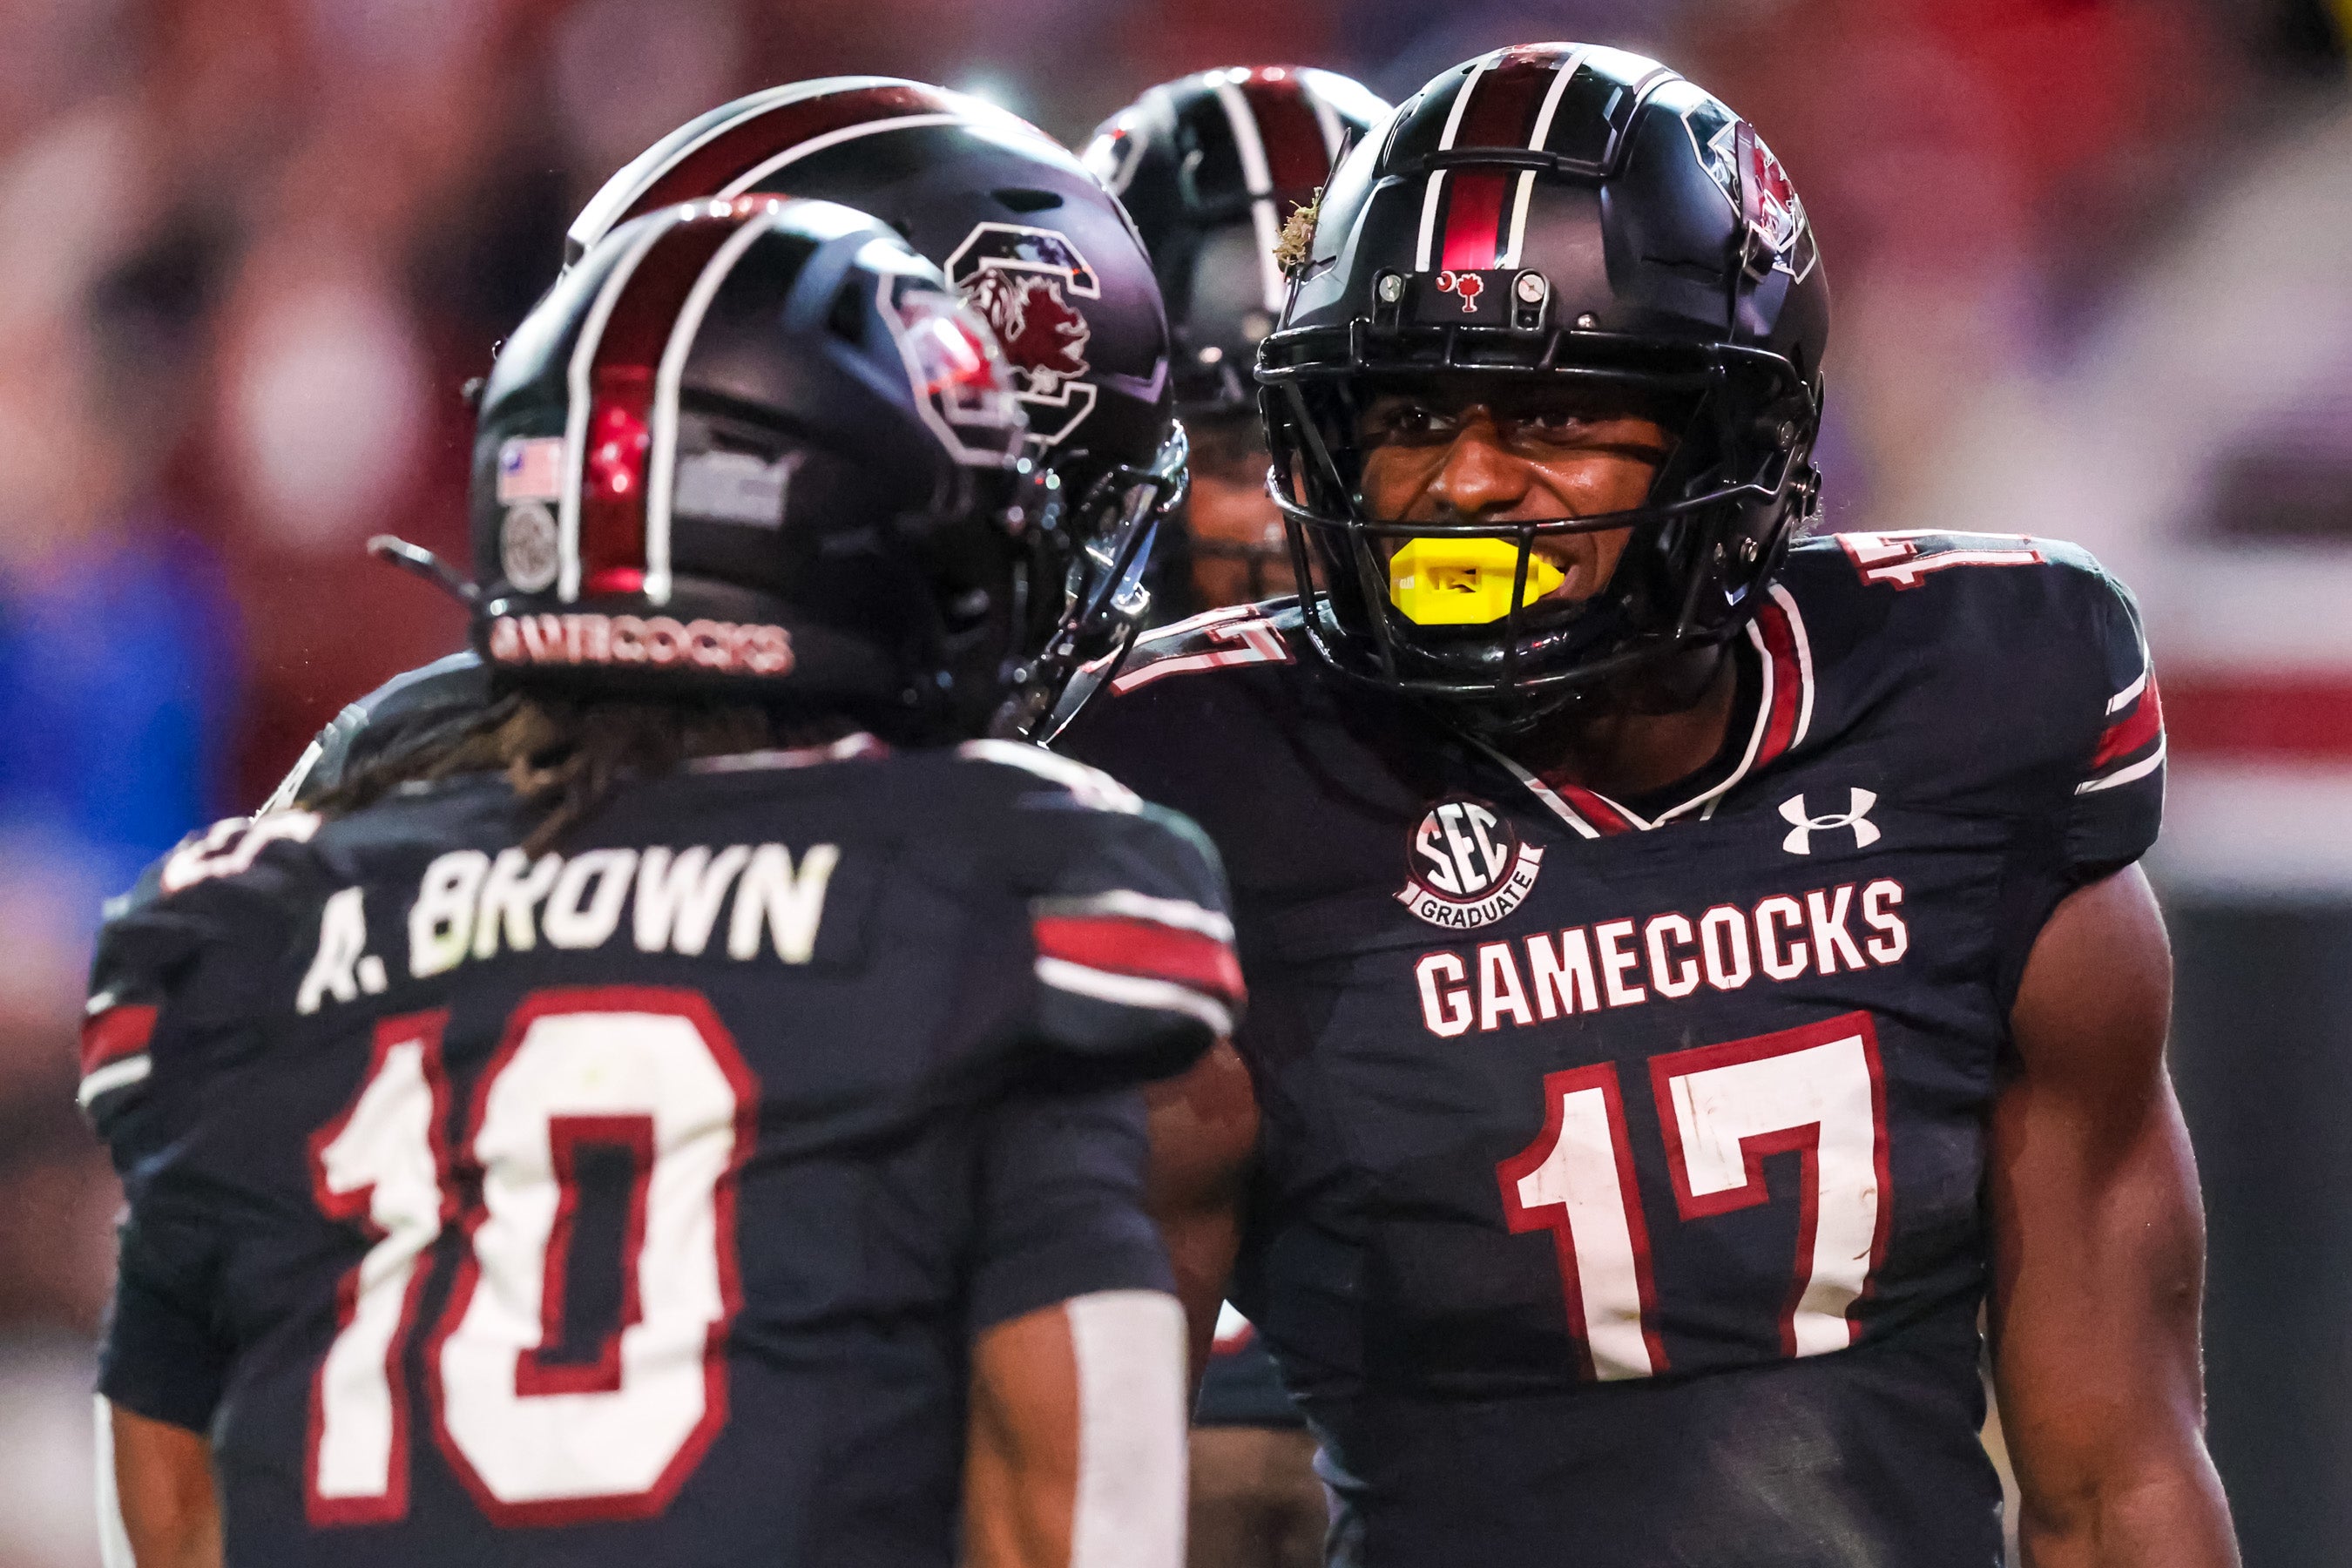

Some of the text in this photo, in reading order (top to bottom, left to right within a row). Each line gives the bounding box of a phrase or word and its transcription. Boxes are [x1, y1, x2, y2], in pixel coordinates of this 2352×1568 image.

[295, 885, 388, 1015] A.
[408, 842, 841, 979] BROWN
[1416, 801, 1508, 895] SEC
[1421, 870, 1532, 928] GRADUATE
[1413, 876, 1910, 1039] GAMECOCKS
[305, 984, 761, 1528] 10
[1495, 1008, 1892, 1383] 17
